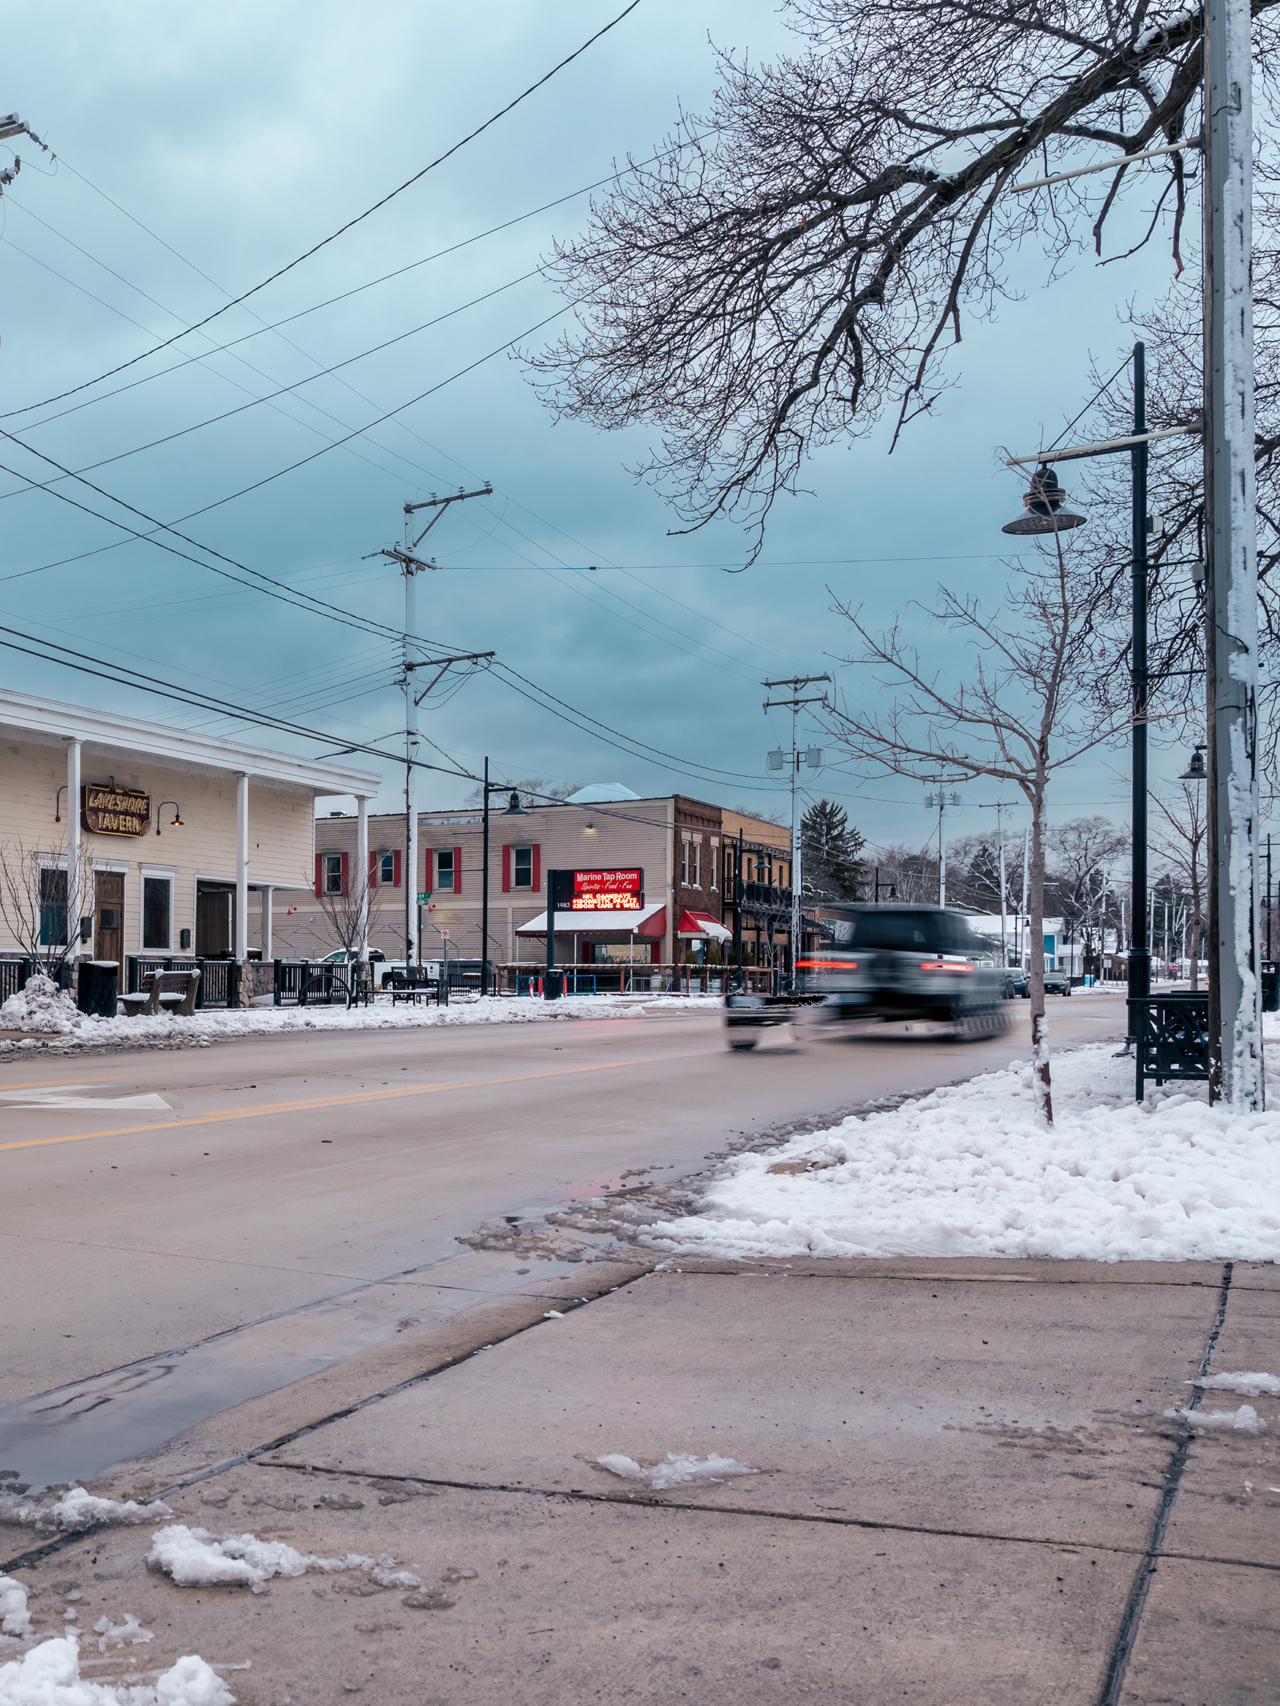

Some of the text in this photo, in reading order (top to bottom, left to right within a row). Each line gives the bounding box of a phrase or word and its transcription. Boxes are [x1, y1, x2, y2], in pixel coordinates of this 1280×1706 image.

[89, 792, 149, 814] LAKESHORE
[97, 812, 141, 833] TAVERN
[576, 872, 637, 882] Marine Tap Room
[581, 881, 633, 891] Spirits Food Fun
